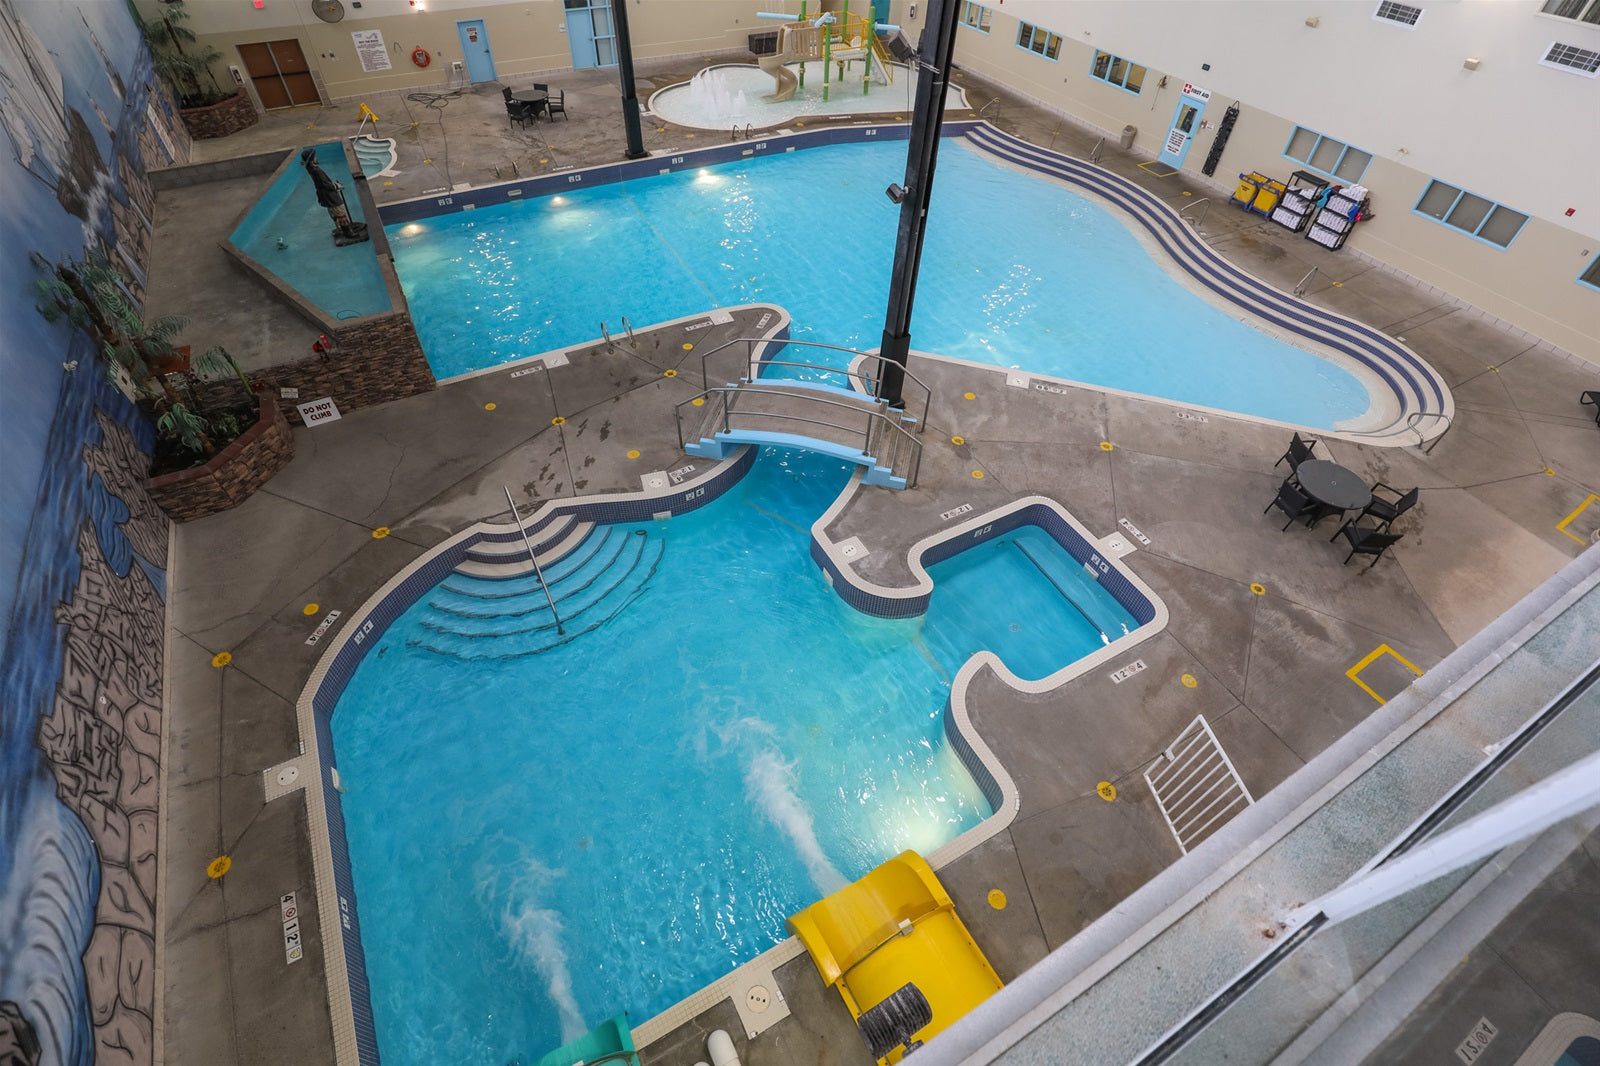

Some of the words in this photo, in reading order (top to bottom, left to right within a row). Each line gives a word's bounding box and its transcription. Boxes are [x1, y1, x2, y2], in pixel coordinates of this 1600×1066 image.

[303, 407, 315, 415] DO
[316, 402, 331, 412] NOT
[310, 410, 333, 421] CLIMB
